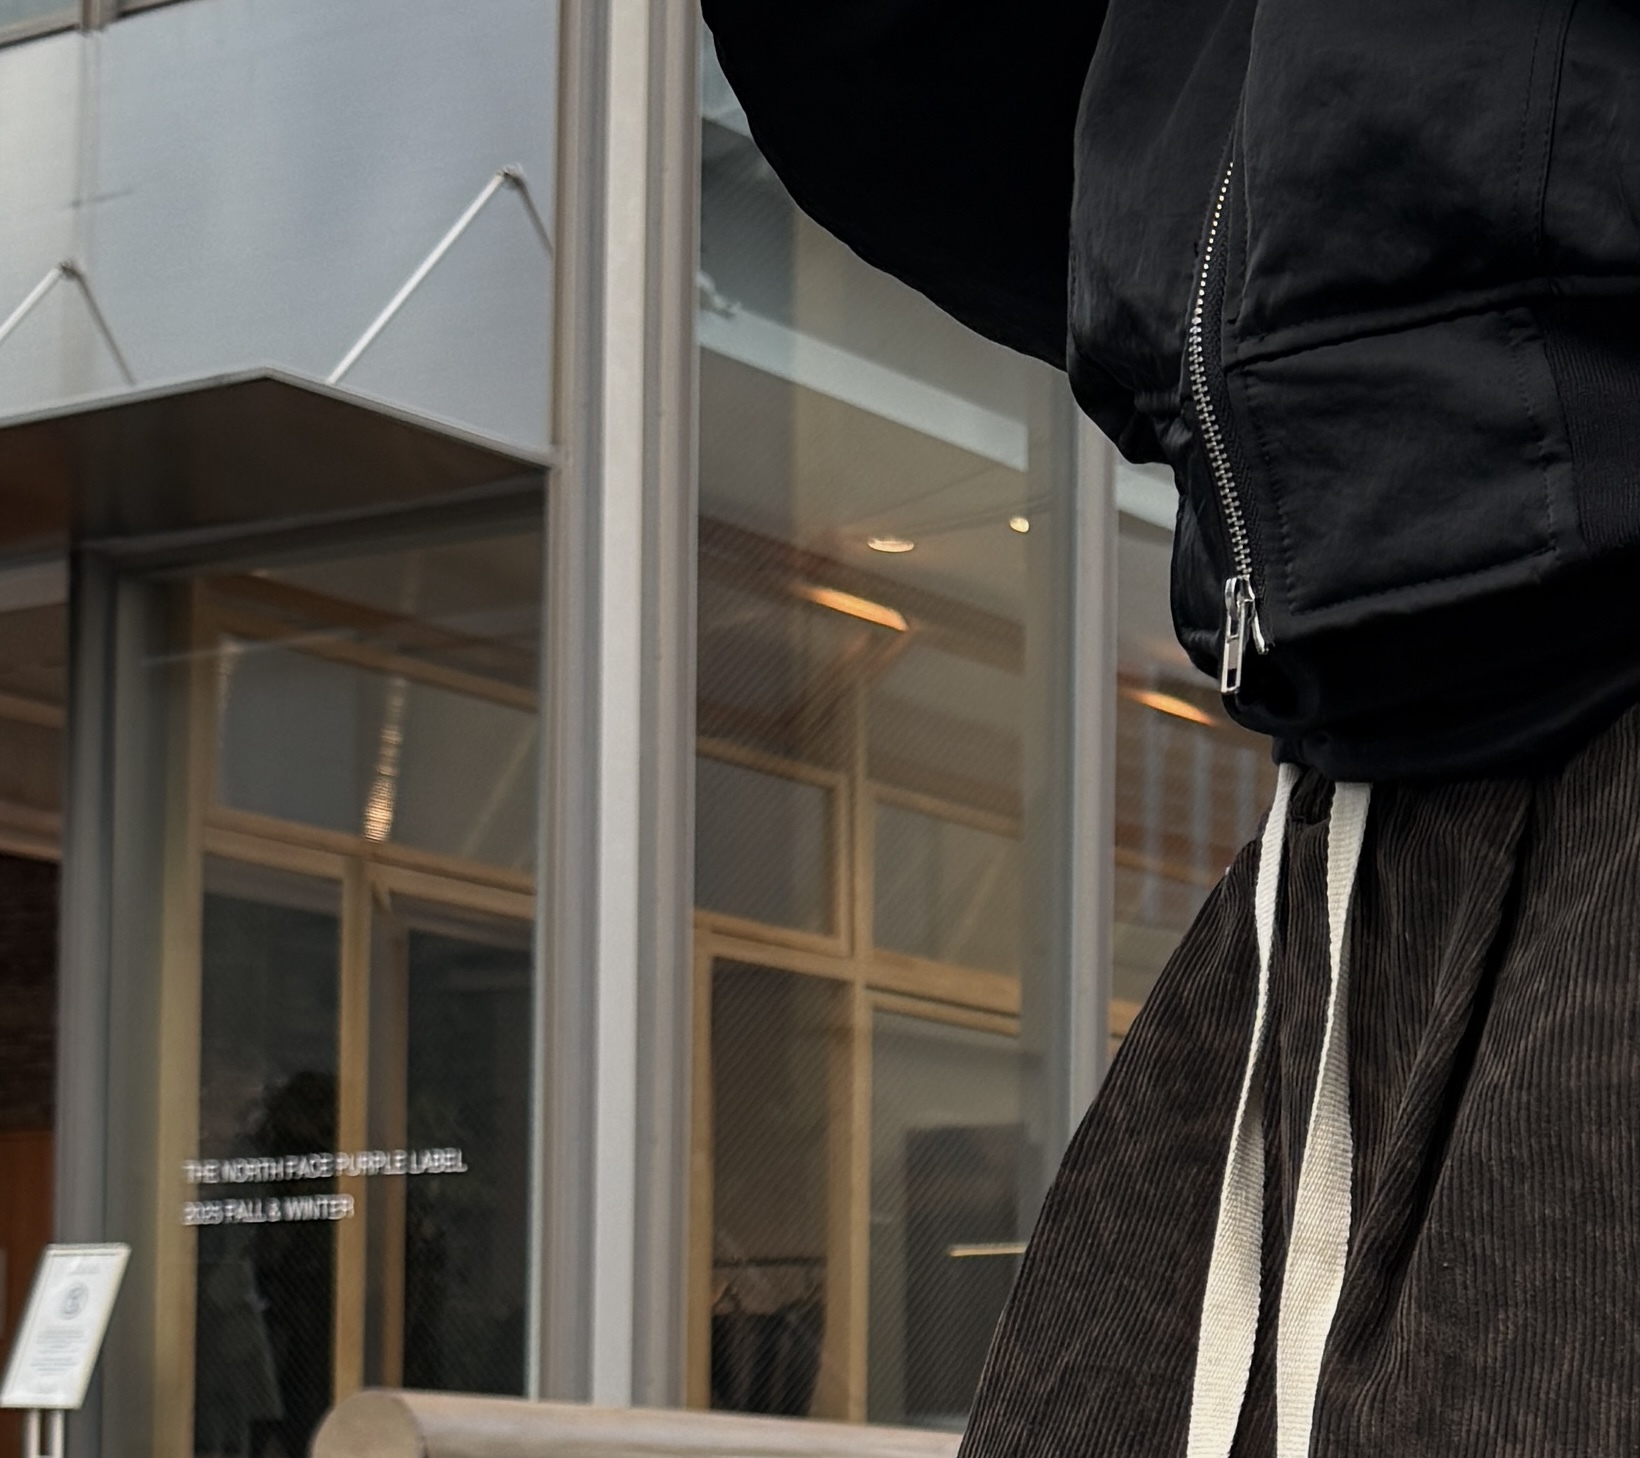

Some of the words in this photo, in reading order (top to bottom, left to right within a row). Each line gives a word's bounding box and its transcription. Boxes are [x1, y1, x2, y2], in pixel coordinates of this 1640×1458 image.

[182, 1159, 220, 1184] THE
[220, 1156, 284, 1184] NORTH
[285, 1152, 335, 1180] FACE
[335, 1150, 407, 1178] PURPLE
[408, 1148, 469, 1175] LABEL
[223, 1197, 267, 1224] FALL
[267, 1197, 282, 1223] &
[283, 1193, 355, 1221] WINTER
